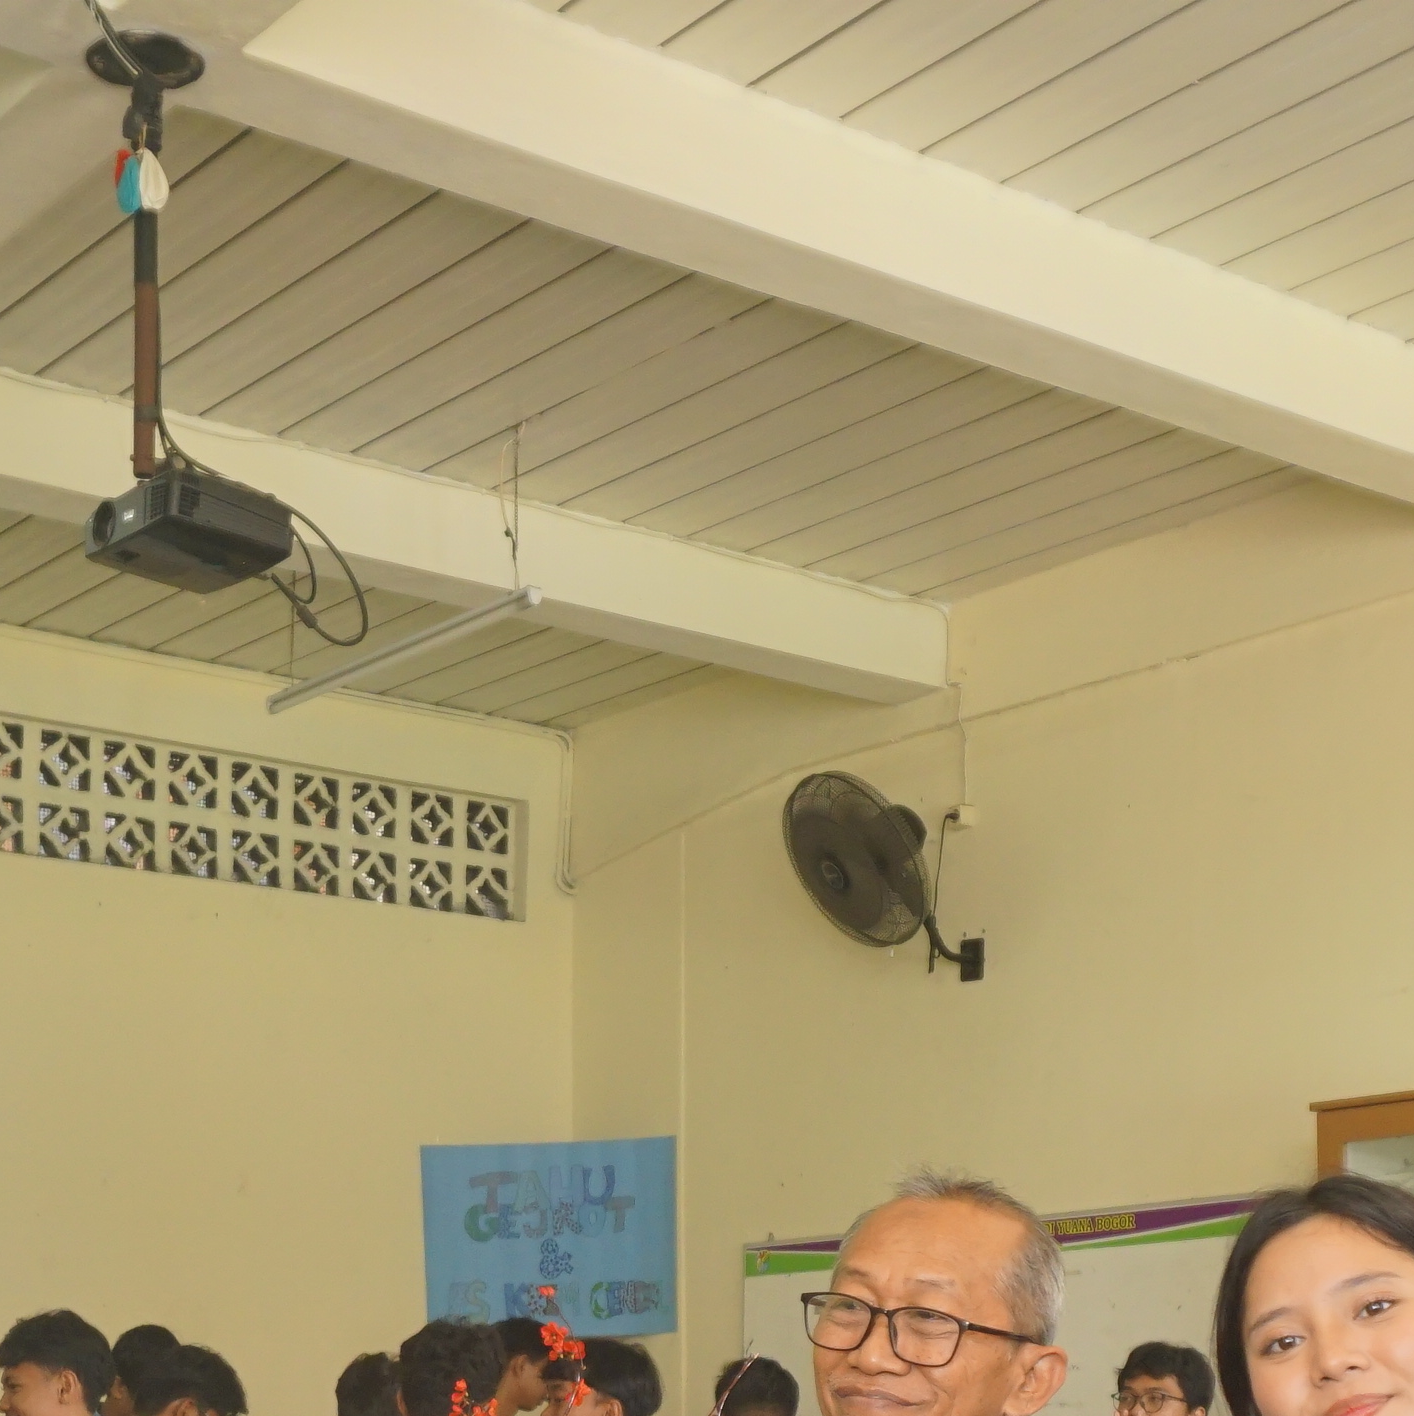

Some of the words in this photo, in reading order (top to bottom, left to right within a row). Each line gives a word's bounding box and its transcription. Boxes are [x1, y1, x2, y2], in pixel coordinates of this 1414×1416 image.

[469, 1165, 615, 1214] TAHU
[464, 1195, 635, 1242] GEJROT
[1057, 1219, 1094, 1235] YUANA
[1096, 1214, 1136, 1232] BOGOR
[540, 1238, 574, 1279] &
[449, 1279, 491, 1324] ES
